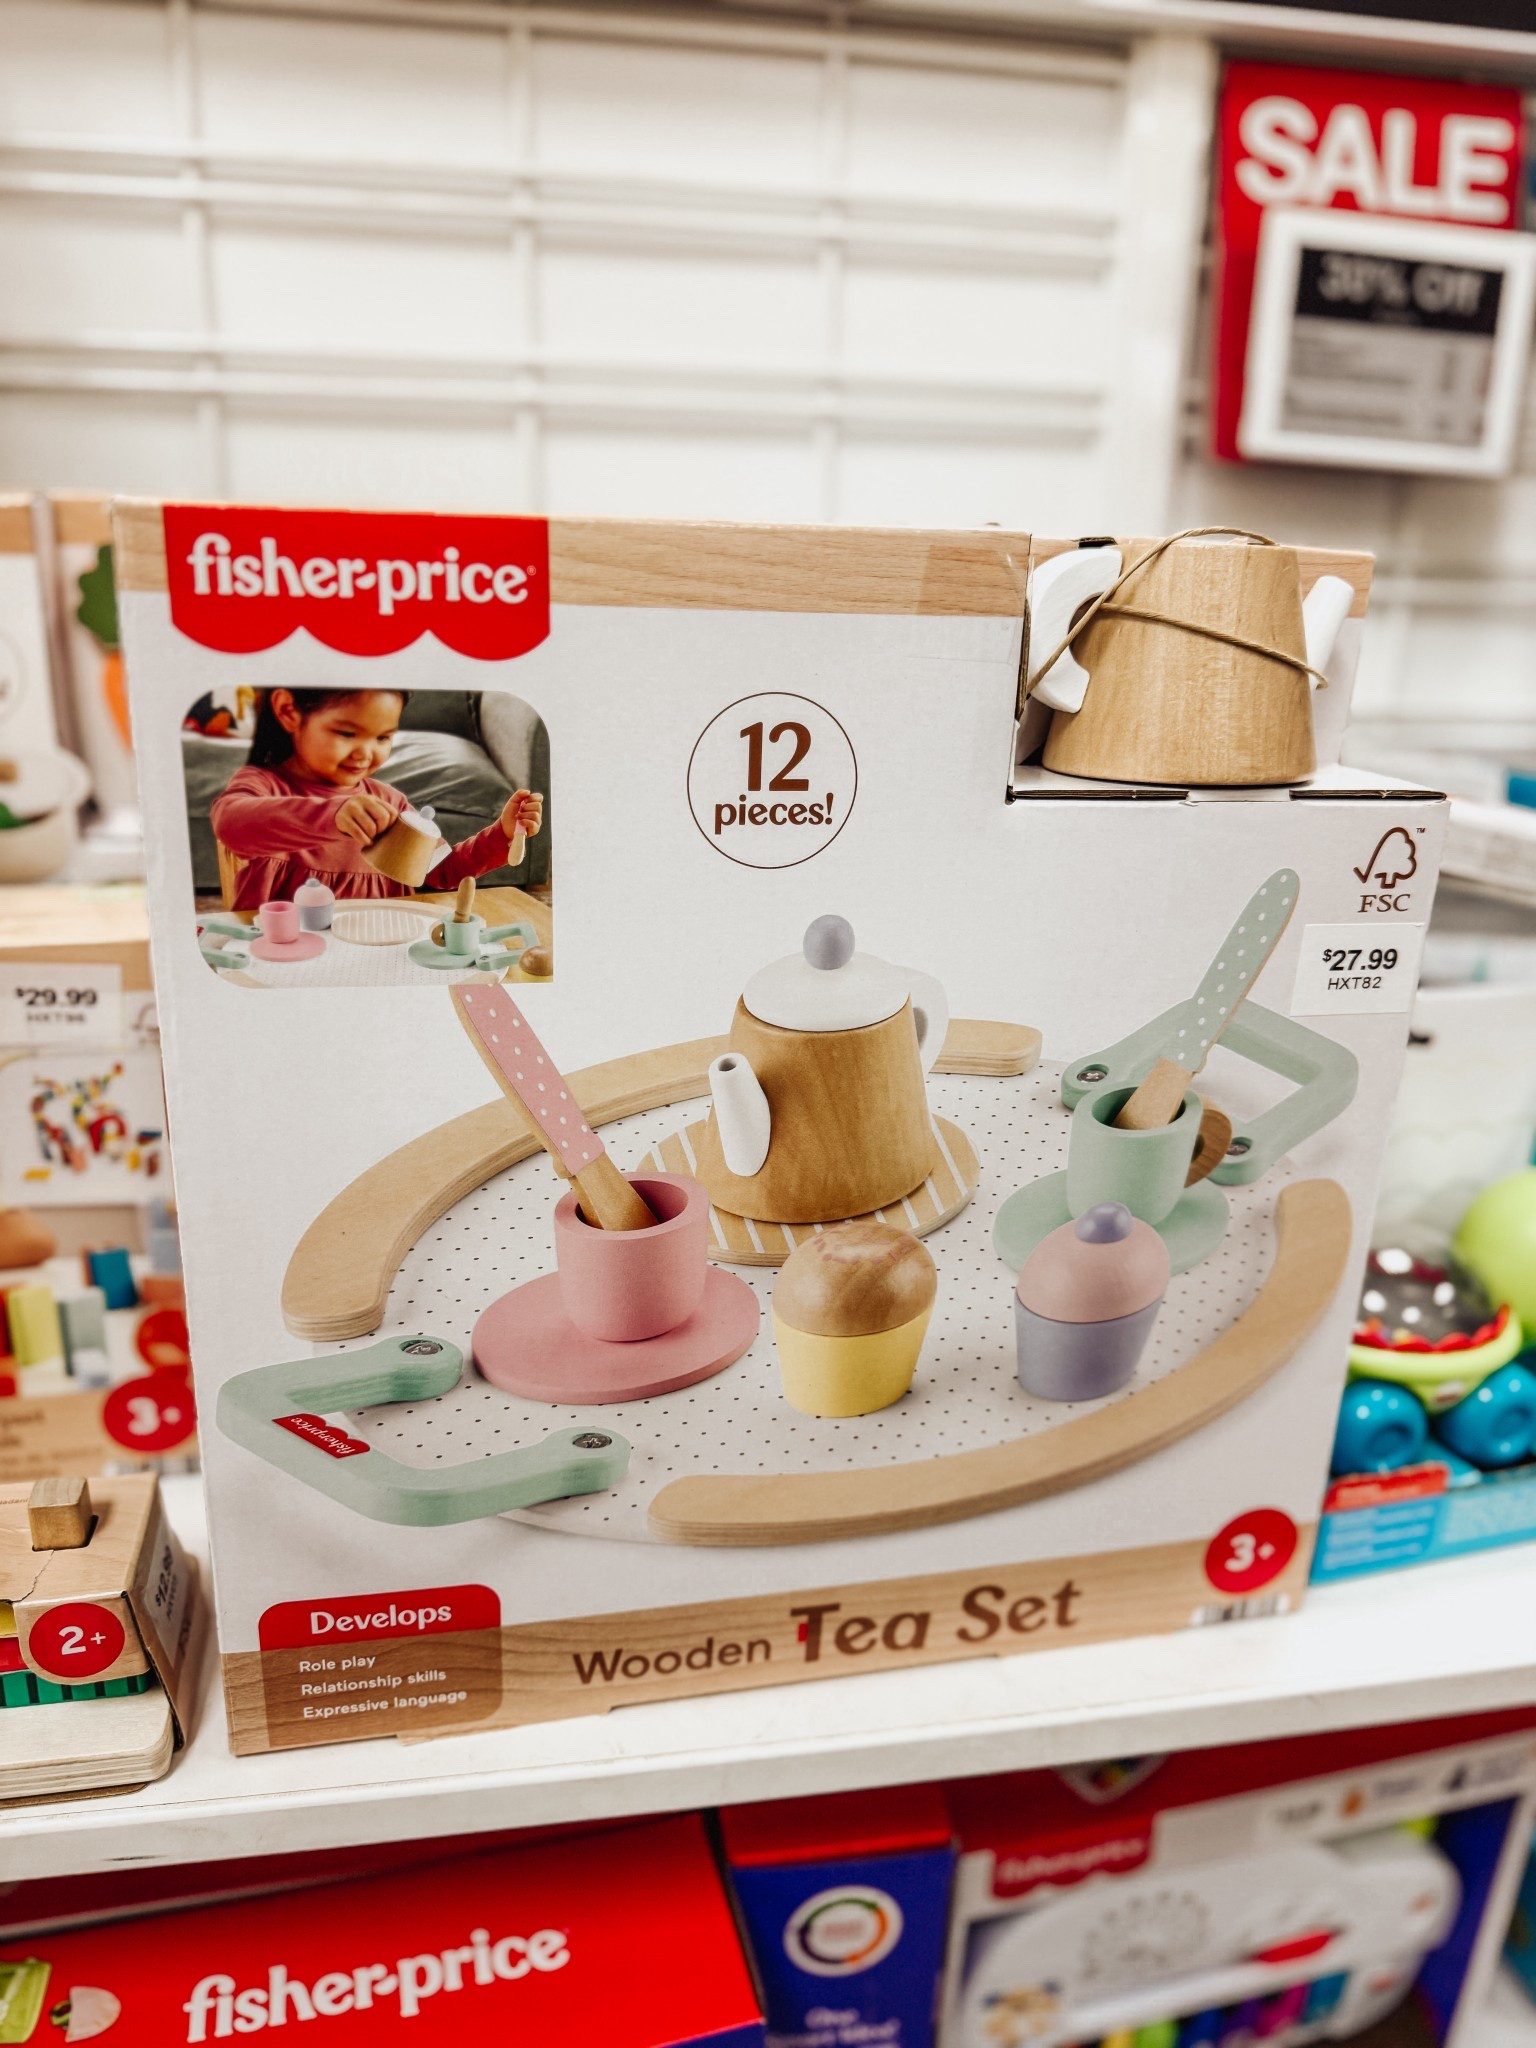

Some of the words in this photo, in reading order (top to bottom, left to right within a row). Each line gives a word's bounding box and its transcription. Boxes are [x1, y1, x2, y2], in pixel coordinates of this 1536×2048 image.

[1235, 95, 1515, 225] SALE
[740, 721, 812, 792] 12
[714, 792, 834, 835] pieces!
[1357, 893, 1411, 914] FSC
[1322, 948, 1398, 972] $27.99
[1327, 976, 1383, 990] HXT82
[1224, 1532, 1276, 1573] 3+
[310, 1604, 452, 1635] Develops
[572, 1636, 772, 1685] Wooden
[790, 1602, 931, 1663] Tea
[956, 1579, 1083, 1643] Set
[58, 1625, 107, 1656] 2+
[299, 1658, 336, 1673] Role
[341, 1655, 376, 1671] play
[301, 1675, 402, 1696] Relationship
[407, 1669, 447, 1685] skills
[303, 1698, 389, 1719] Expressive
[394, 1689, 467, 1709] language
